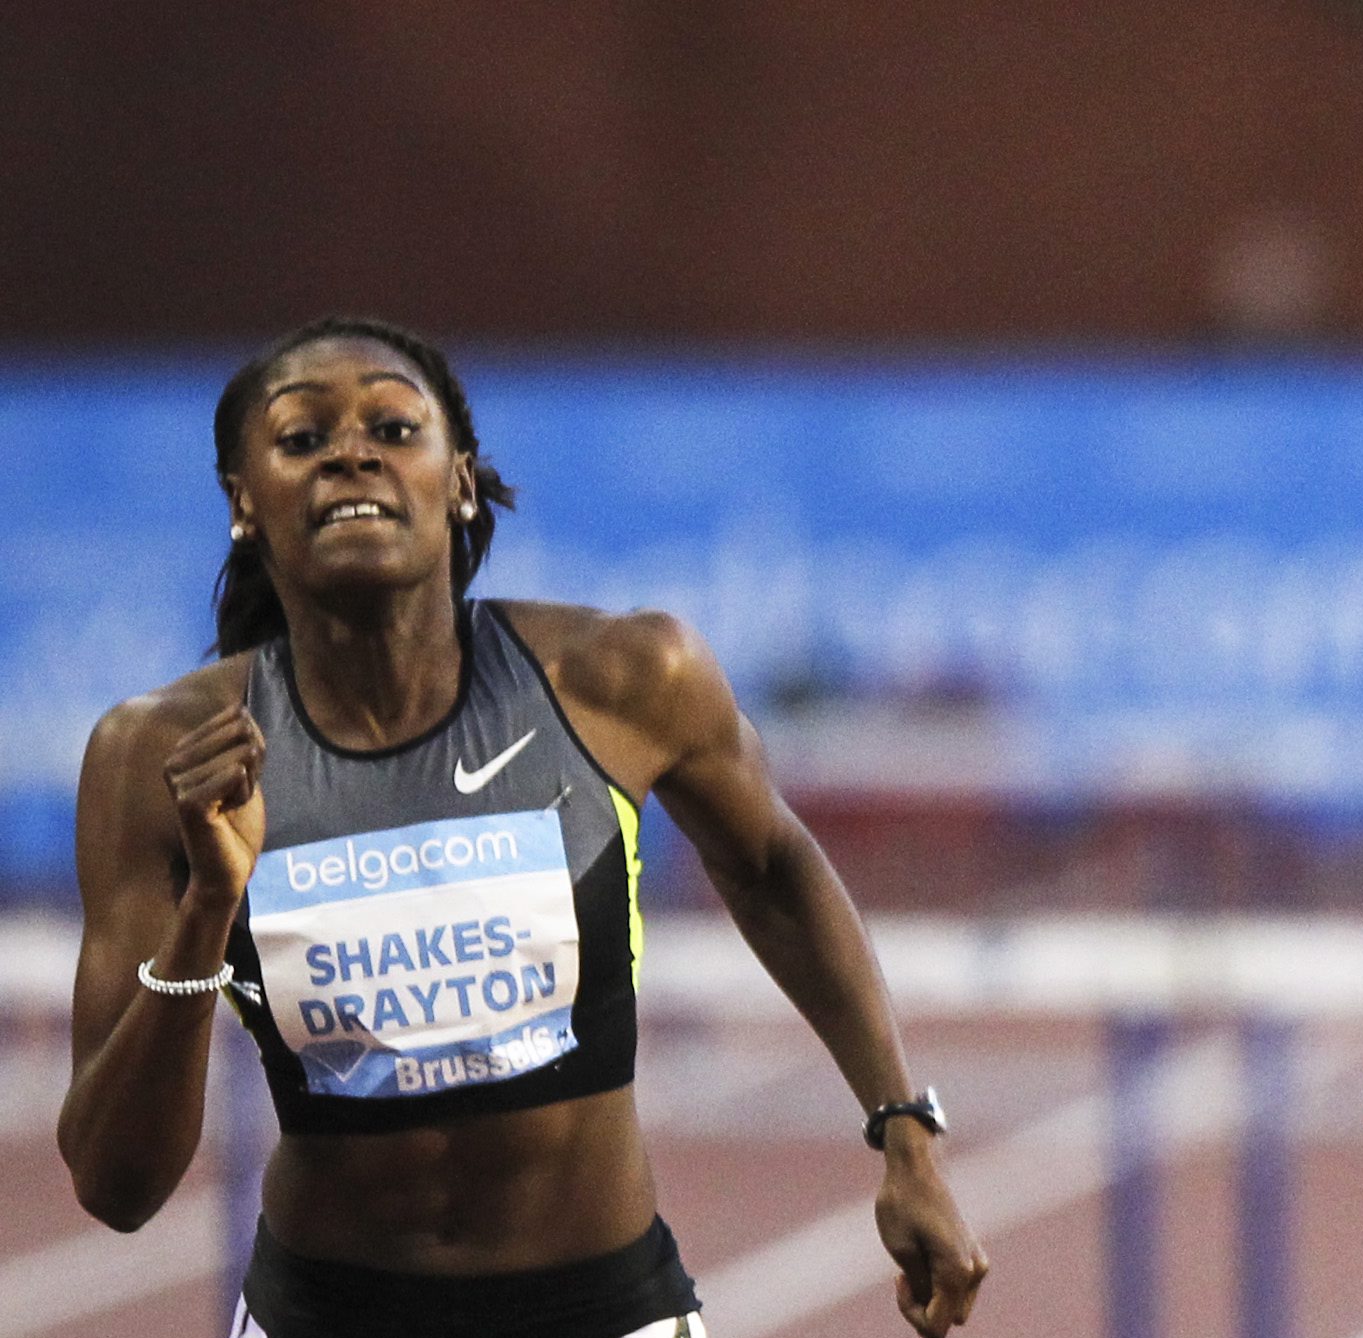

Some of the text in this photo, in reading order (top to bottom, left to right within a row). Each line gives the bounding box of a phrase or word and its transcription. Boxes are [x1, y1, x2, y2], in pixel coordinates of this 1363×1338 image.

[286, 830, 518, 891] belgacom
[305, 916, 532, 987] SHAKES-
[298, 962, 556, 1035] DRAYTON
[396, 1024, 554, 1092] Brussels
